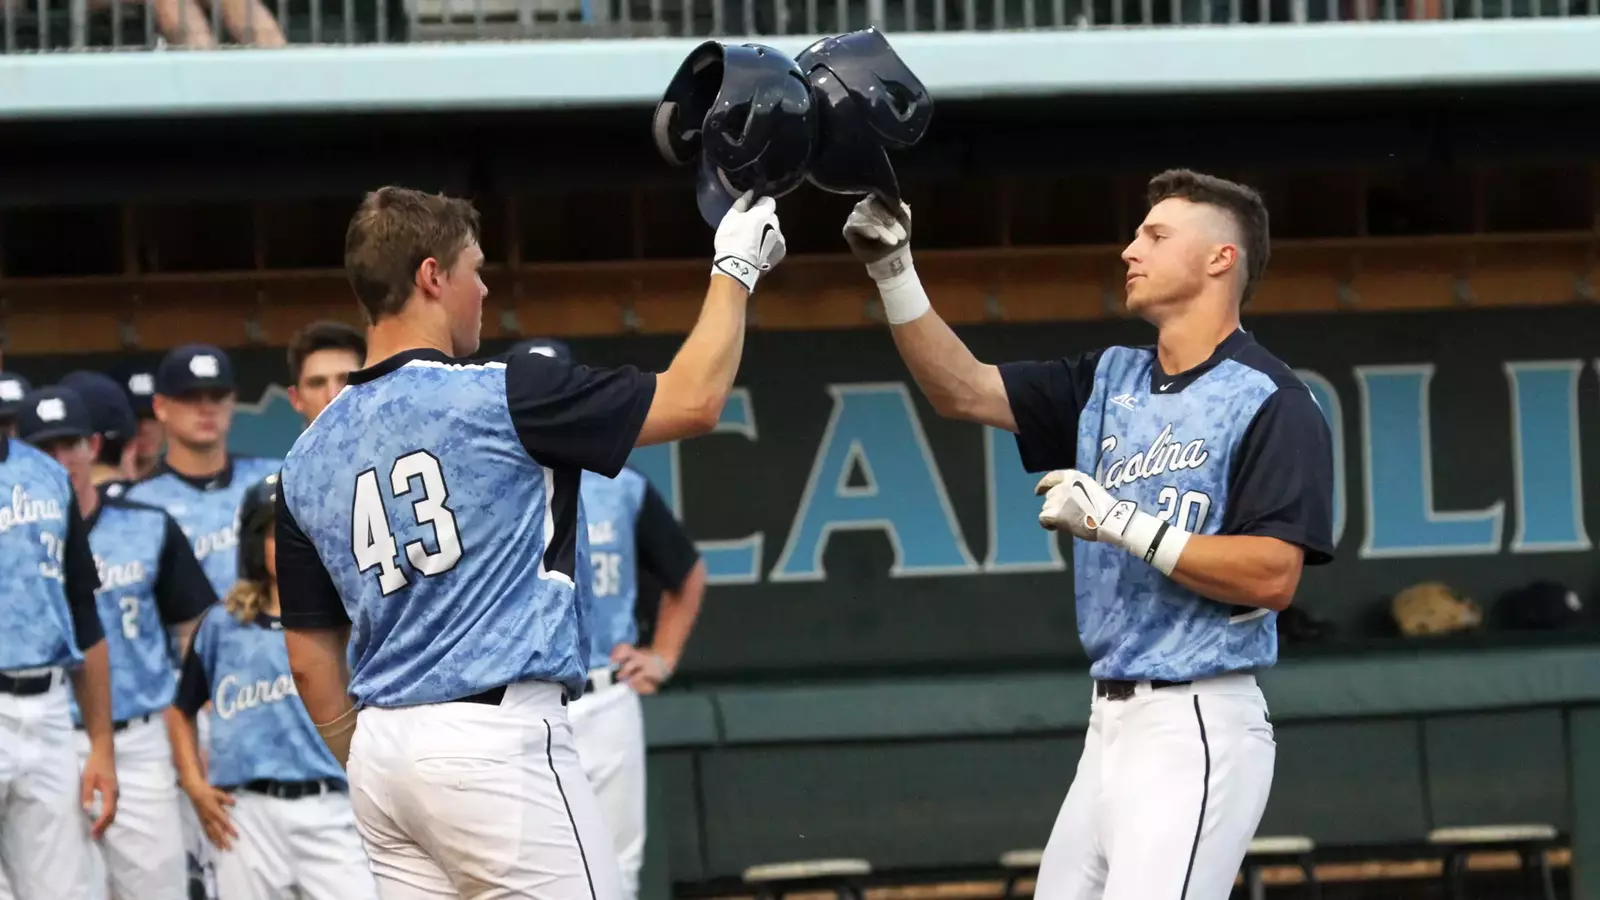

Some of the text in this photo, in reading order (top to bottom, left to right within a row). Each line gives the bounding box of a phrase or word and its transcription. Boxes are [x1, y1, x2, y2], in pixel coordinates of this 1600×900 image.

[1095, 422, 1209, 490] Caolina
[351, 448, 465, 598] 43
[1156, 485, 1212, 534] 20
[119, 597, 139, 640] 2
